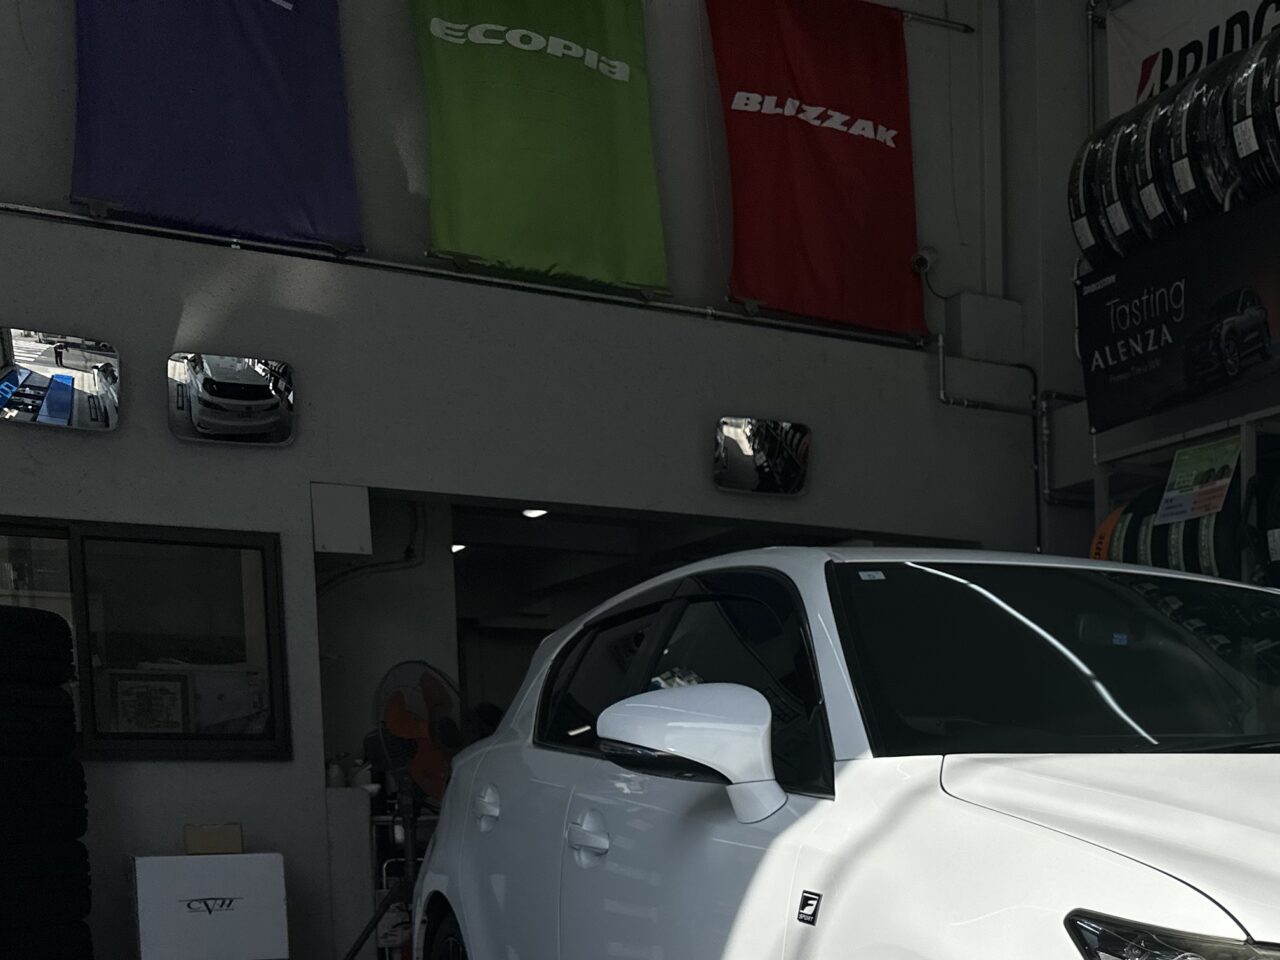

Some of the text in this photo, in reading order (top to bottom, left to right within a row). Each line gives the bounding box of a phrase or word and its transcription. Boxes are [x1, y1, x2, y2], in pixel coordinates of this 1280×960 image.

[731, 91, 899, 149] BLIZZAK
[1105, 278, 1186, 334] Tasting
[1090, 323, 1174, 372] ALENZA
